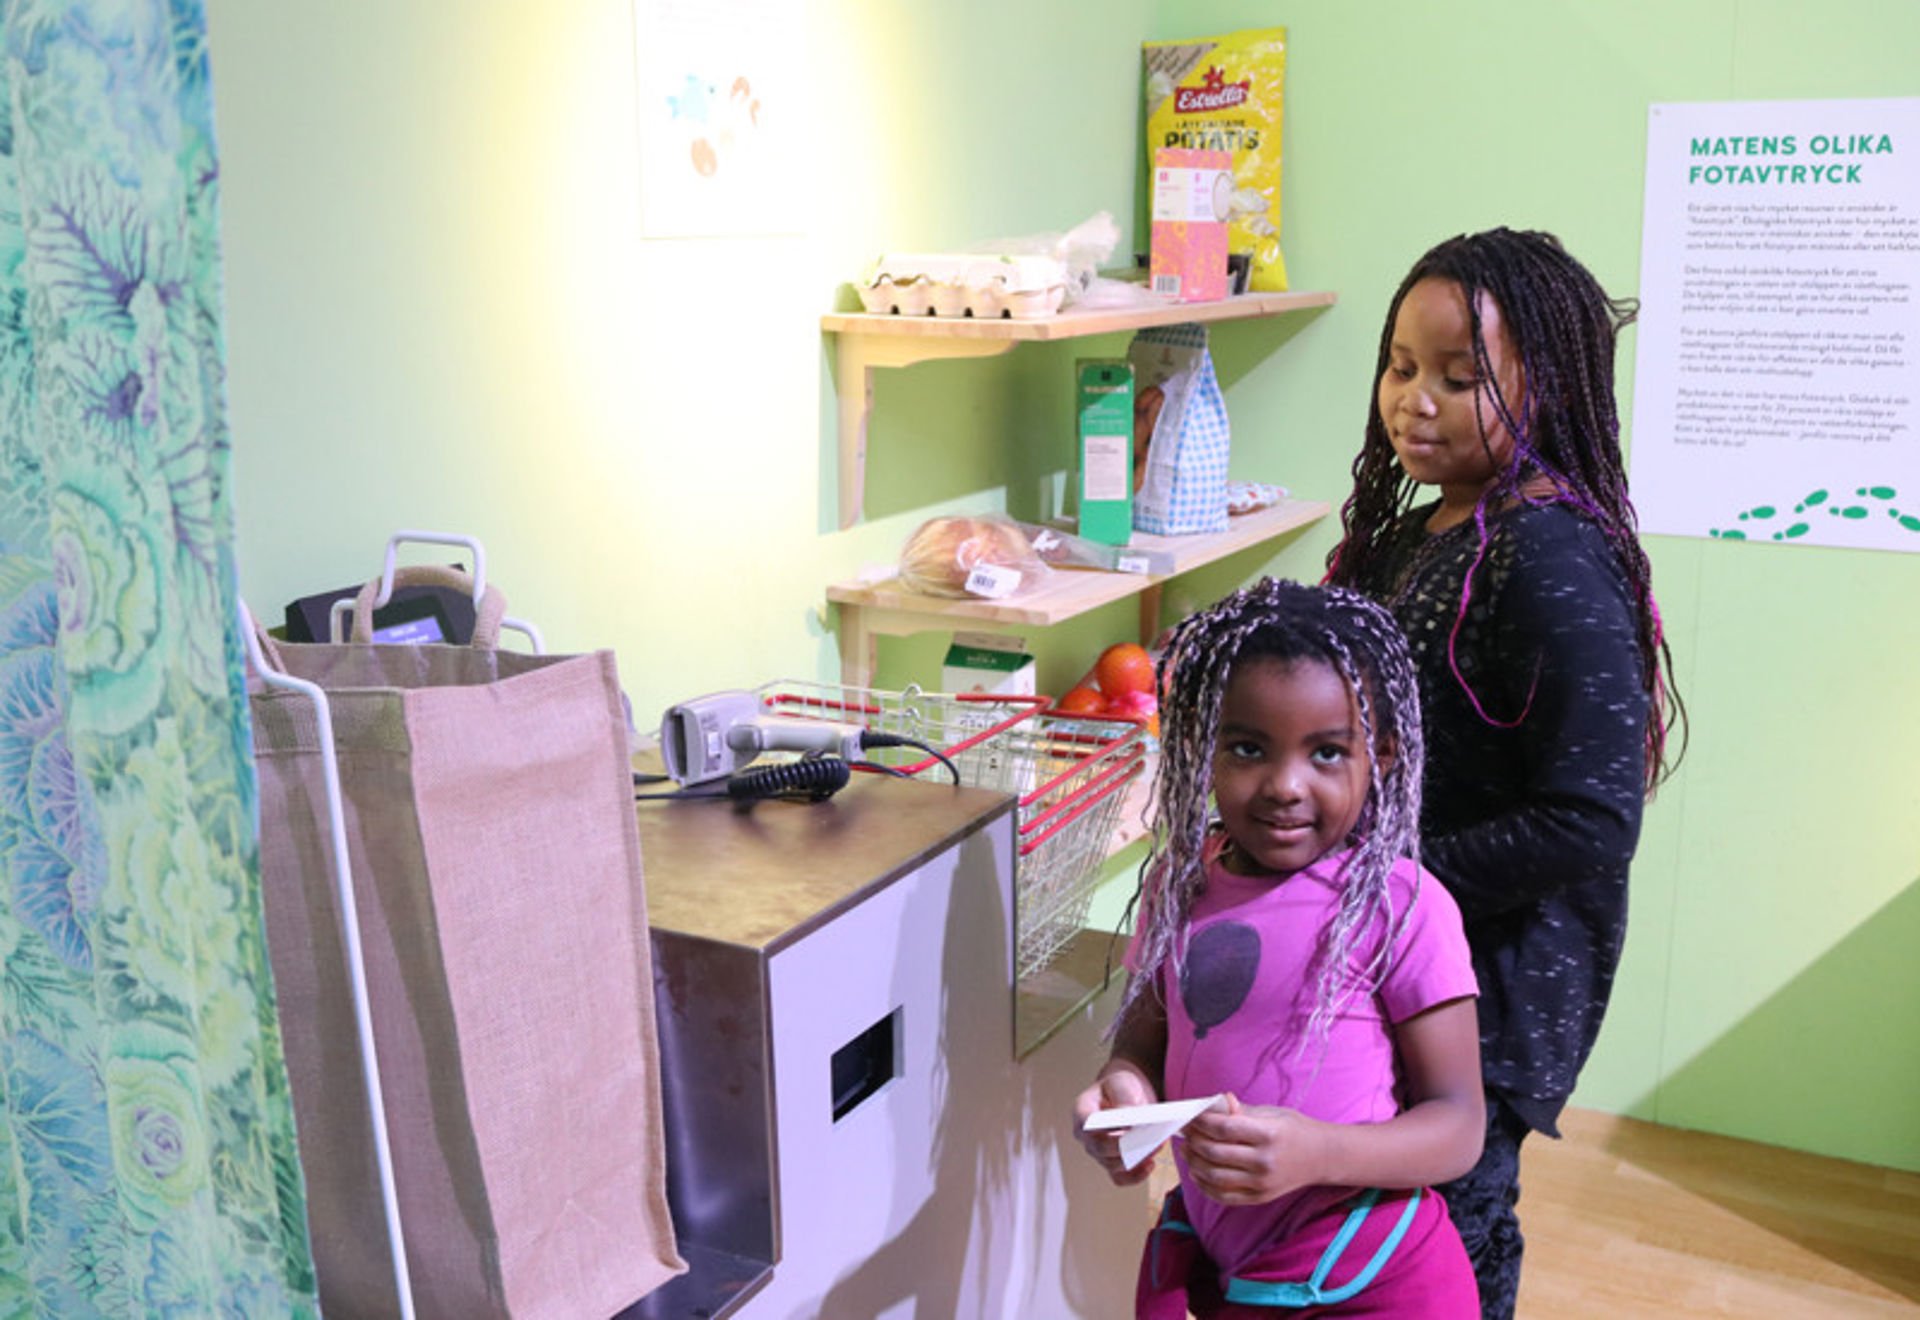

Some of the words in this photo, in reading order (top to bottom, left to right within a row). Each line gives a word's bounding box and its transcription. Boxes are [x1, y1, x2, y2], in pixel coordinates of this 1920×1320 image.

[1178, 87, 1246, 110] Estrella
[1164, 129, 1259, 151] POTATIS
[1690, 135, 1797, 156] MATENS
[1809, 134, 1893, 155] OLIKA
[1689, 164, 1861, 184] FOTAVTRYCK
